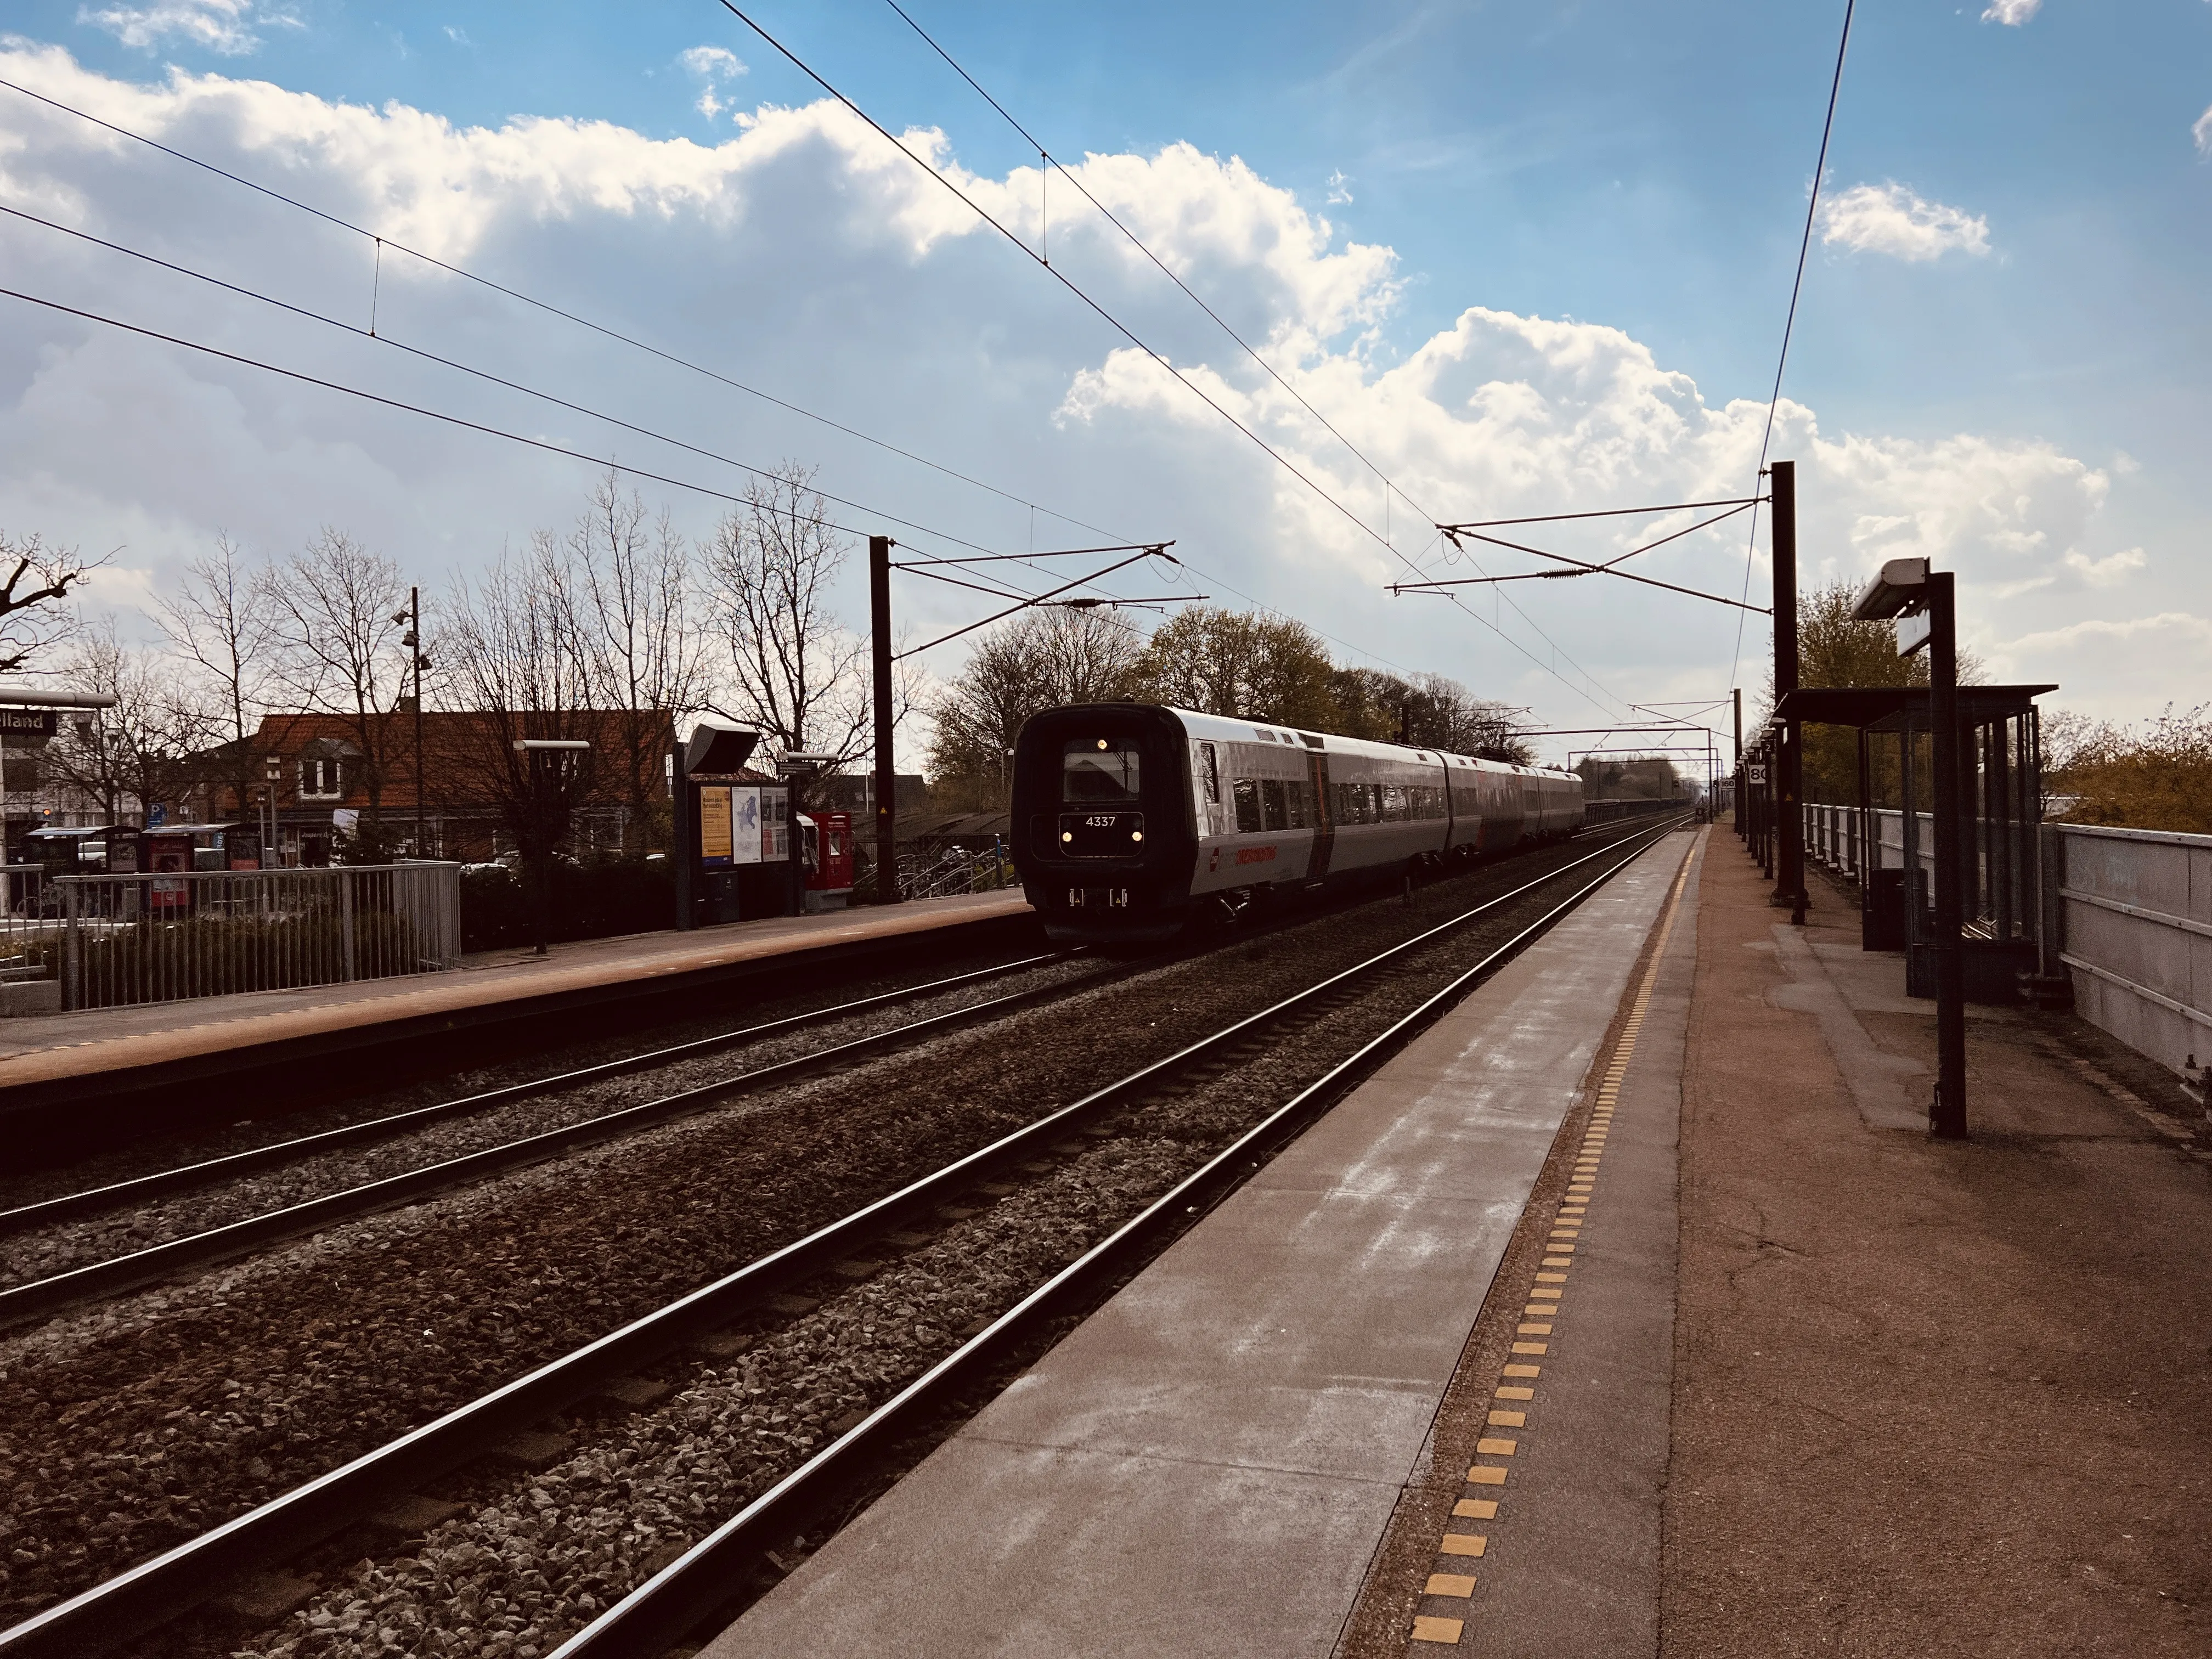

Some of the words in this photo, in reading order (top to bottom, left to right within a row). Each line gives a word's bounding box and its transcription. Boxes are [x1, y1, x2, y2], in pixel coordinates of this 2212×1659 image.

[0, 713, 43, 728] lland
[151, 805, 160, 816] P
[1086, 816, 1115, 826] 4337
